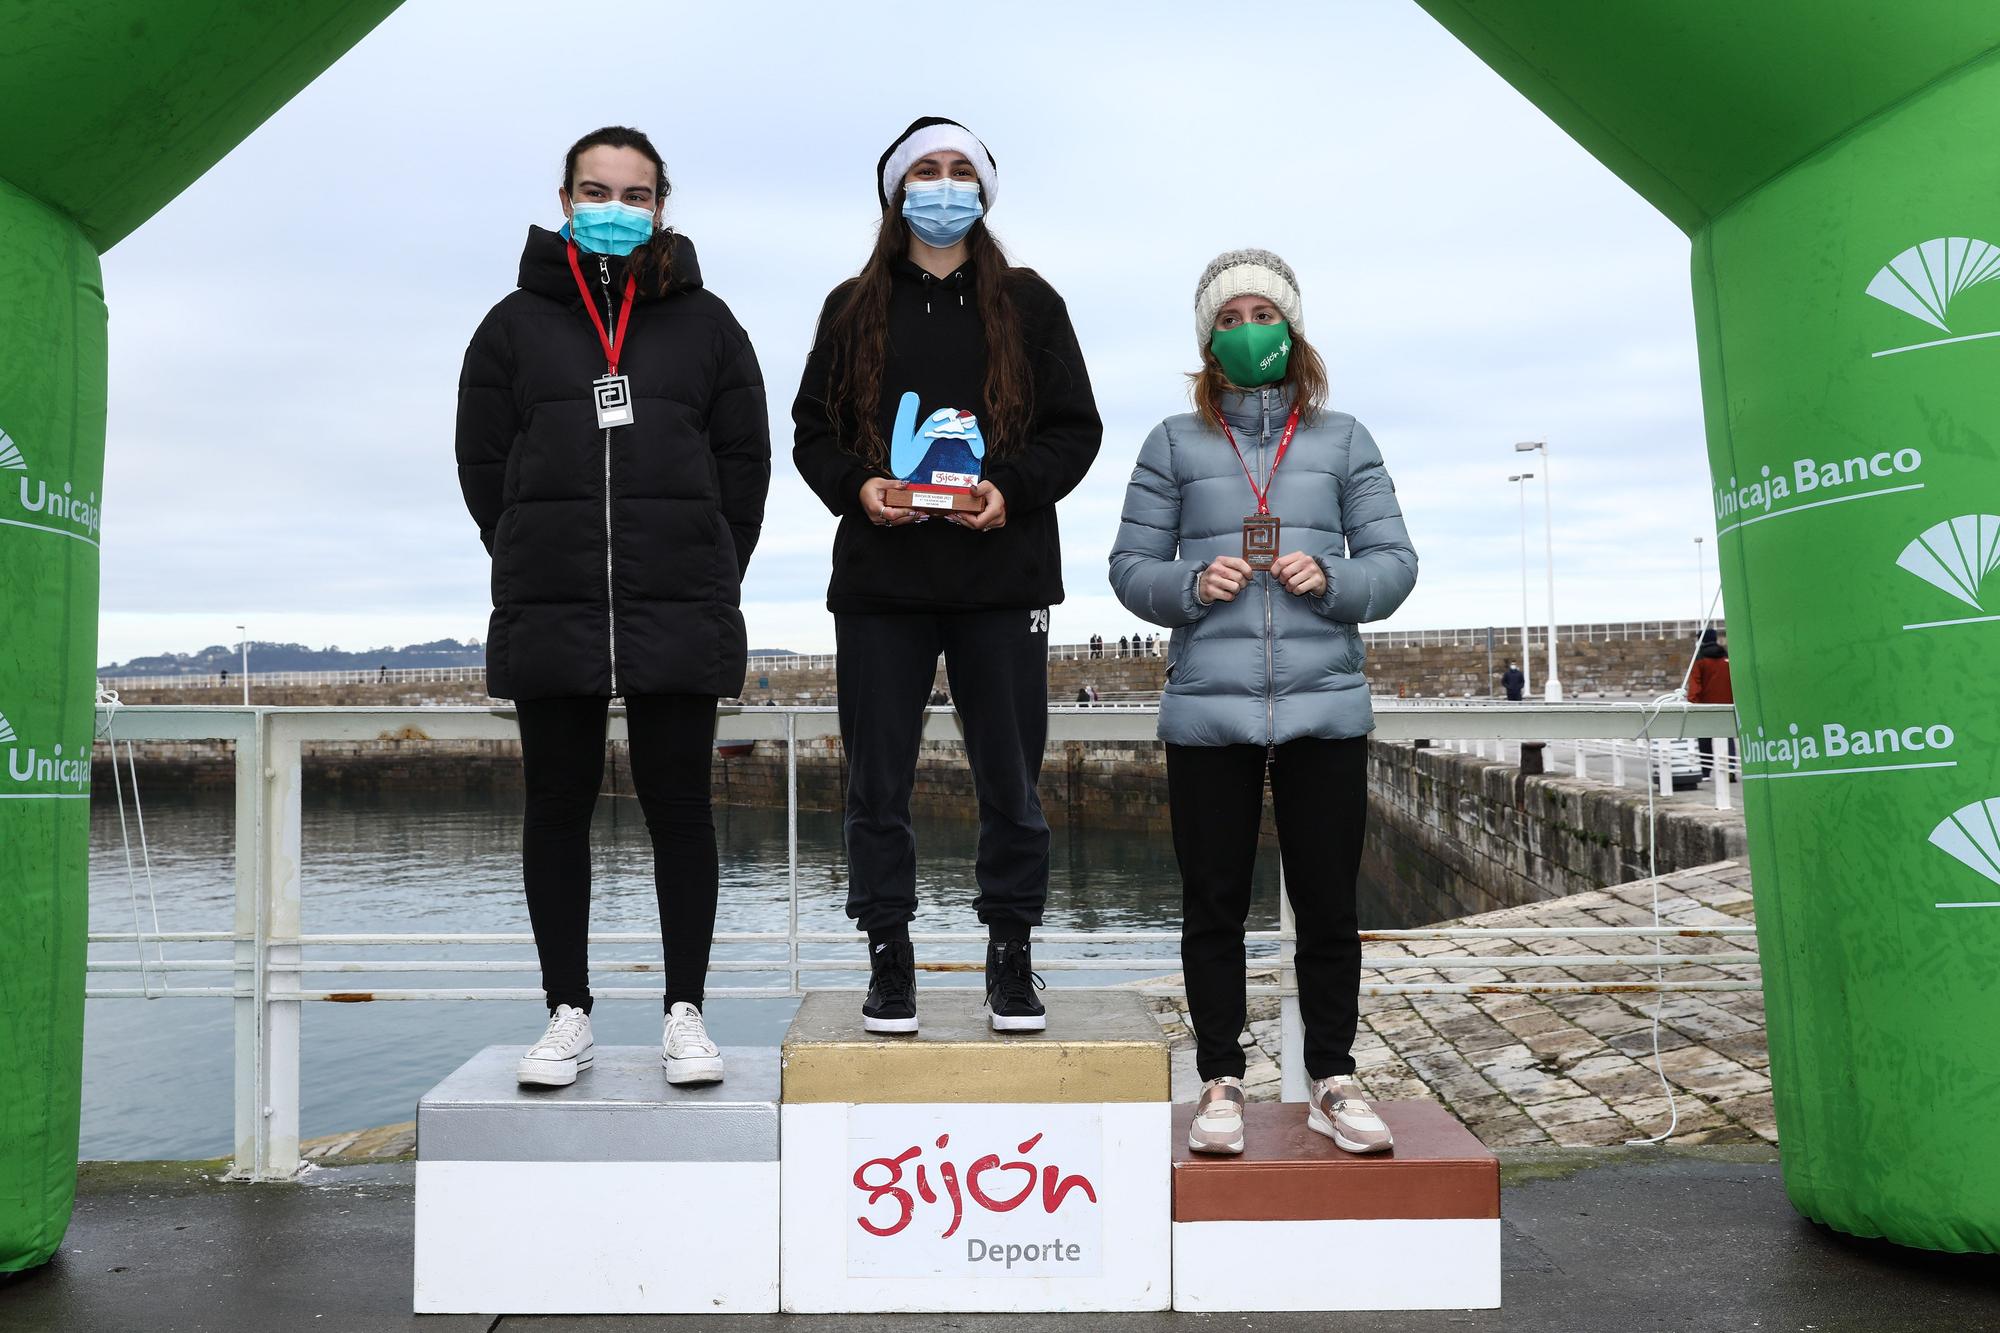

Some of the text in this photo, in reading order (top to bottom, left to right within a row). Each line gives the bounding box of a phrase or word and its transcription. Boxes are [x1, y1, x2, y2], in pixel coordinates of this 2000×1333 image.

[1715, 448, 1922, 512] Unicaja Banco
[20, 476, 98, 536] Unicaja
[1030, 609, 1047, 632] 79
[9, 743, 89, 792] Unicaja
[1741, 723, 1954, 769] Unicaja Banco
[853, 1132, 1097, 1239] gijón
[967, 1238, 1081, 1269] Deporte
